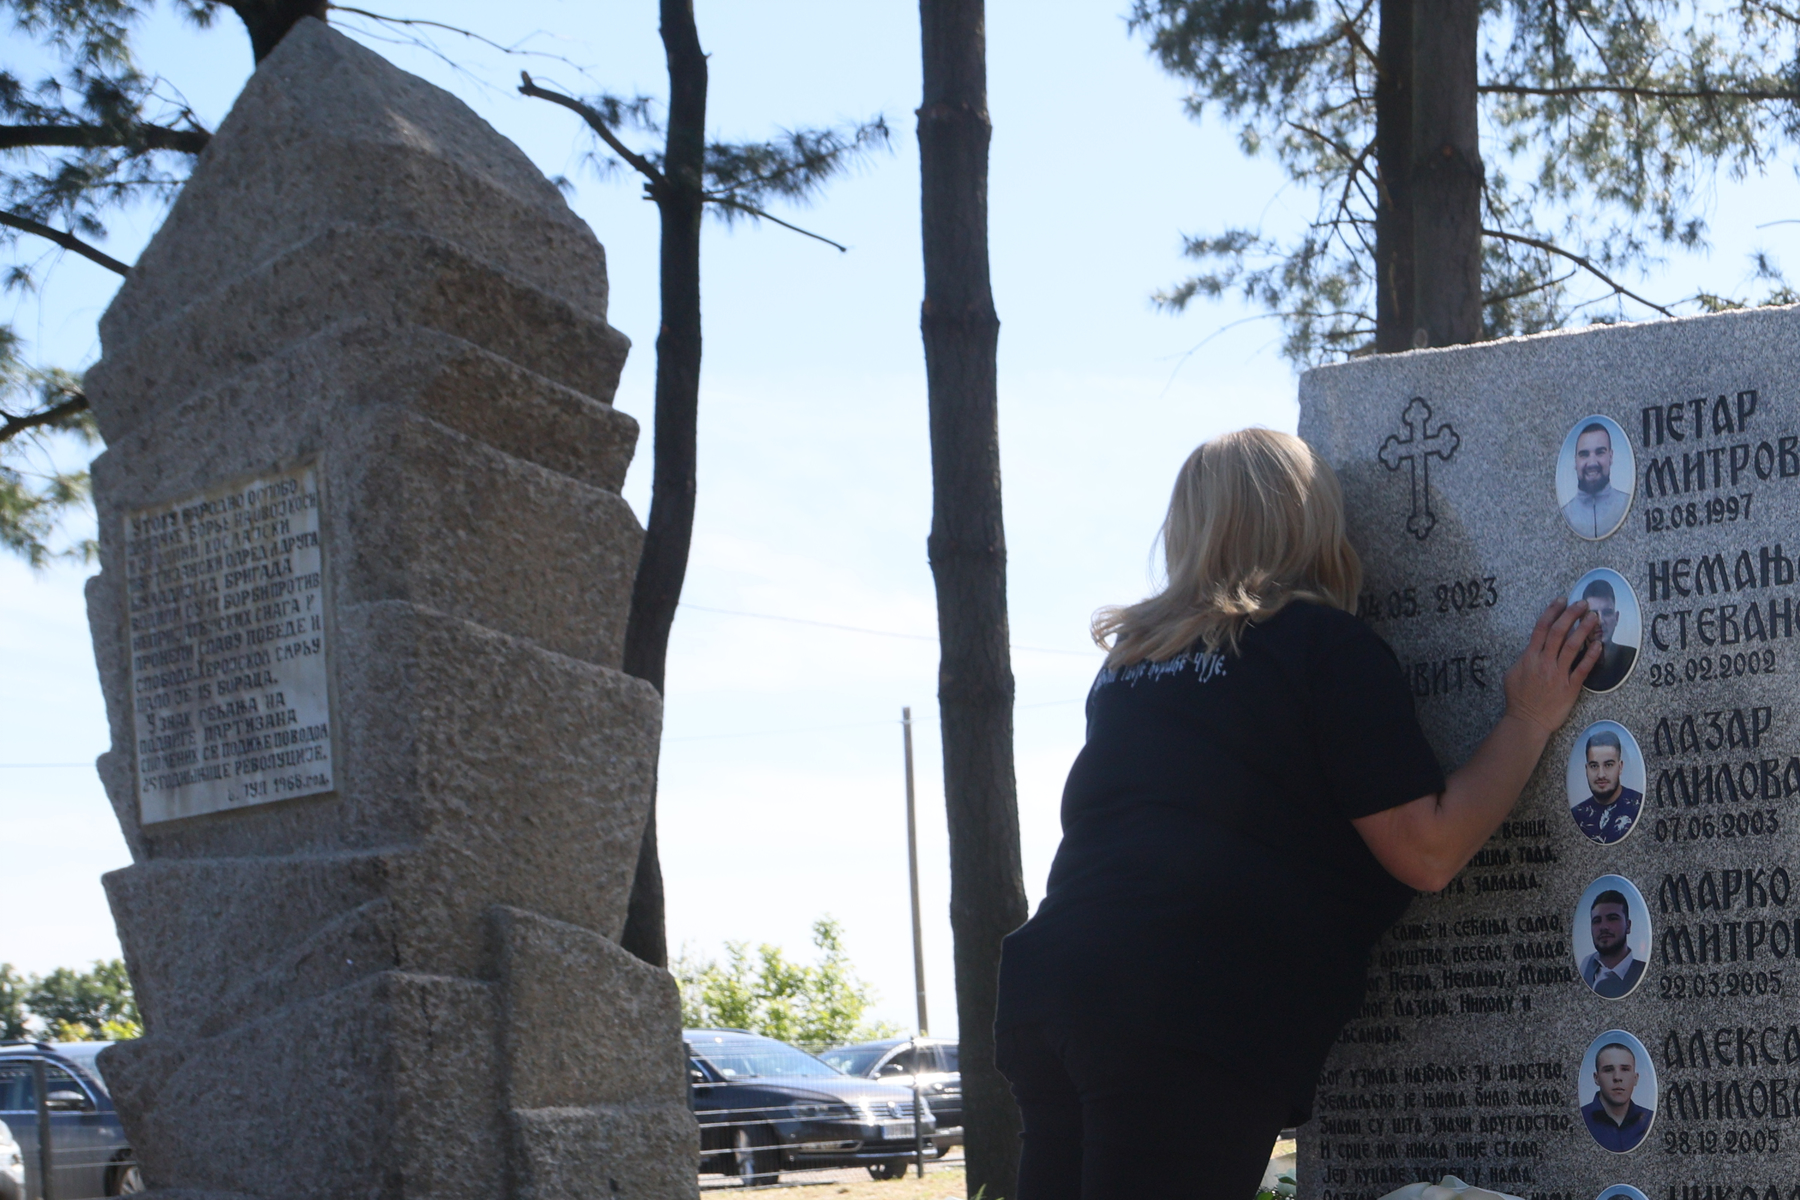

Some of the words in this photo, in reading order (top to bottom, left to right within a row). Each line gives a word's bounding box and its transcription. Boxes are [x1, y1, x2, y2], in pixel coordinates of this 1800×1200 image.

[1643, 390, 1758, 447] ПЕТАР
[1644, 493, 1754, 533] 12.08.1997
[224, 557, 292, 589] БРИГАДА
[254, 597, 300, 623] СНАГА
[1435, 577, 1498, 613] 2023
[246, 617, 305, 646] ПОБЕДЕ
[1649, 648, 1777, 689] 28.02.2002
[264, 691, 285, 710] НА
[203, 708, 297, 741] ПАРТИЗАНА
[1654, 706, 1773, 757] ЛАЗАР
[202, 744, 219, 762] СЕ
[234, 743, 327, 776] РЕВОЛУЦИЈЕ.
[1655, 808, 1779, 842] 07.06.2003
[1659, 866, 1791, 913] МАРКО
[1659, 970, 1782, 1000] 22.03.2005
[1665, 1127, 1781, 1155] 28.12.2005
